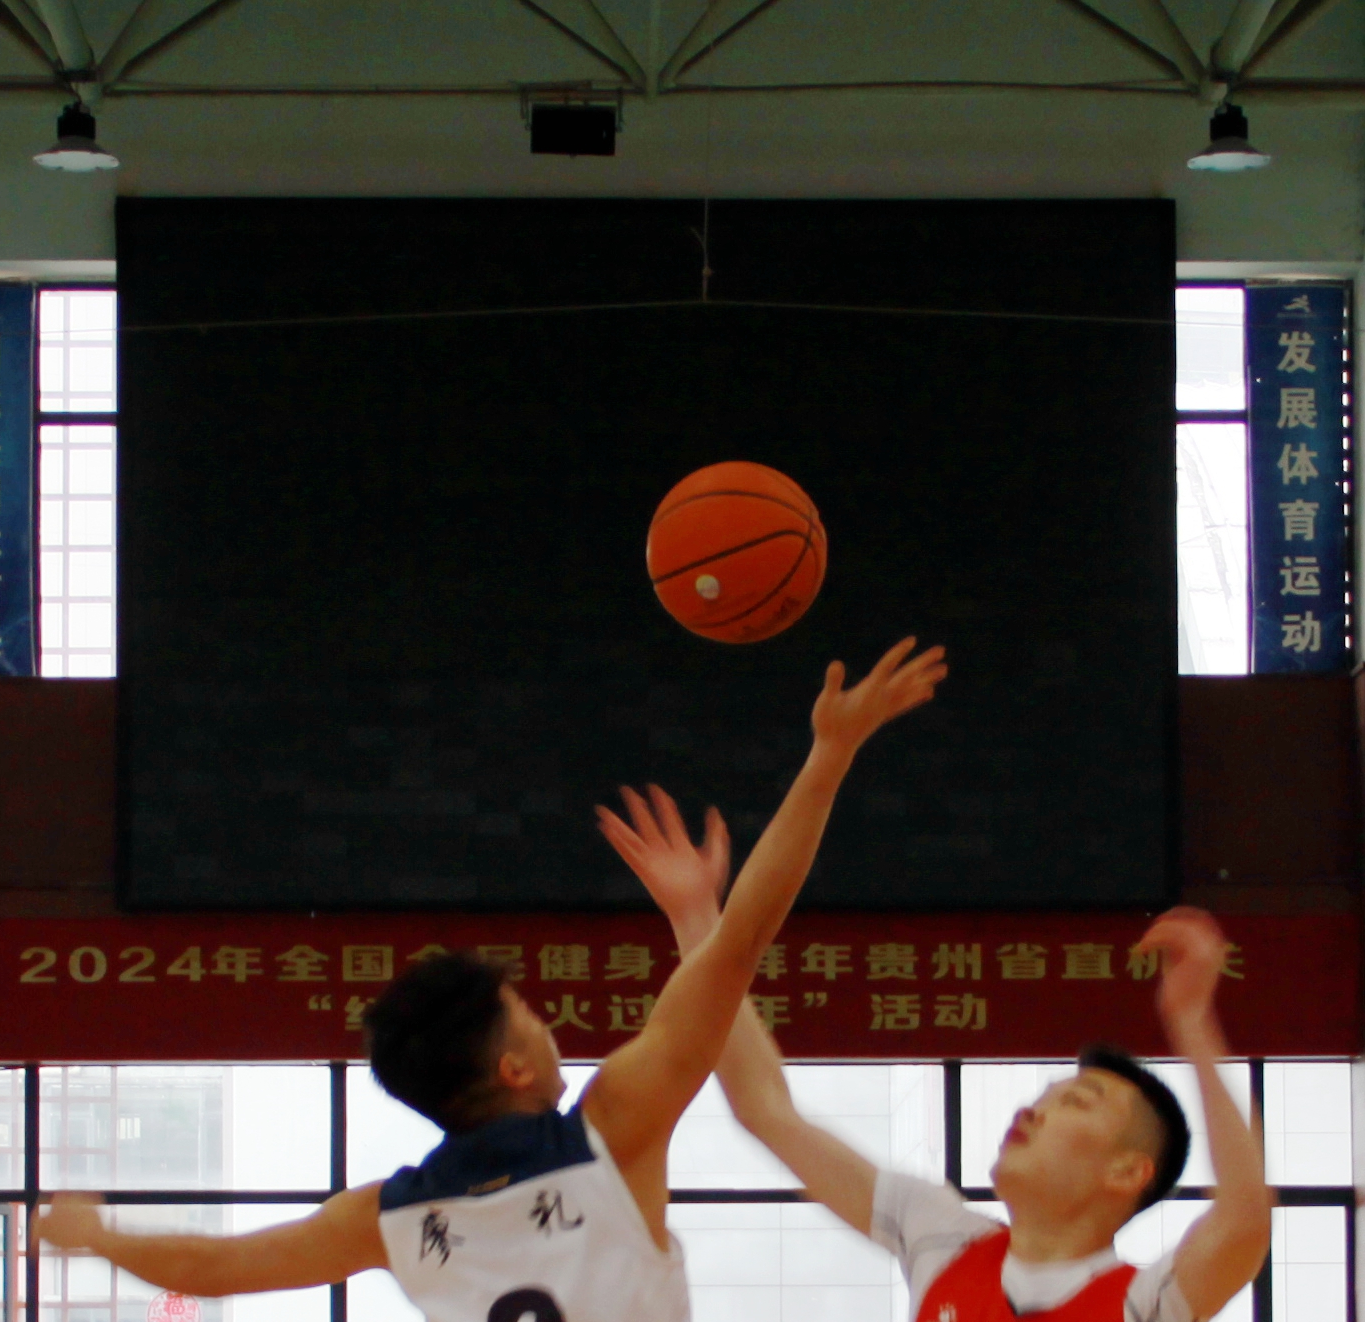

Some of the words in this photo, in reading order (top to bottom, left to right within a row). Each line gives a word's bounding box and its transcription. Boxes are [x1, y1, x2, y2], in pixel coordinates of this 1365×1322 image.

[1276, 332, 1321, 653] 发展体育运动
[870, 992, 987, 1031] 活动
